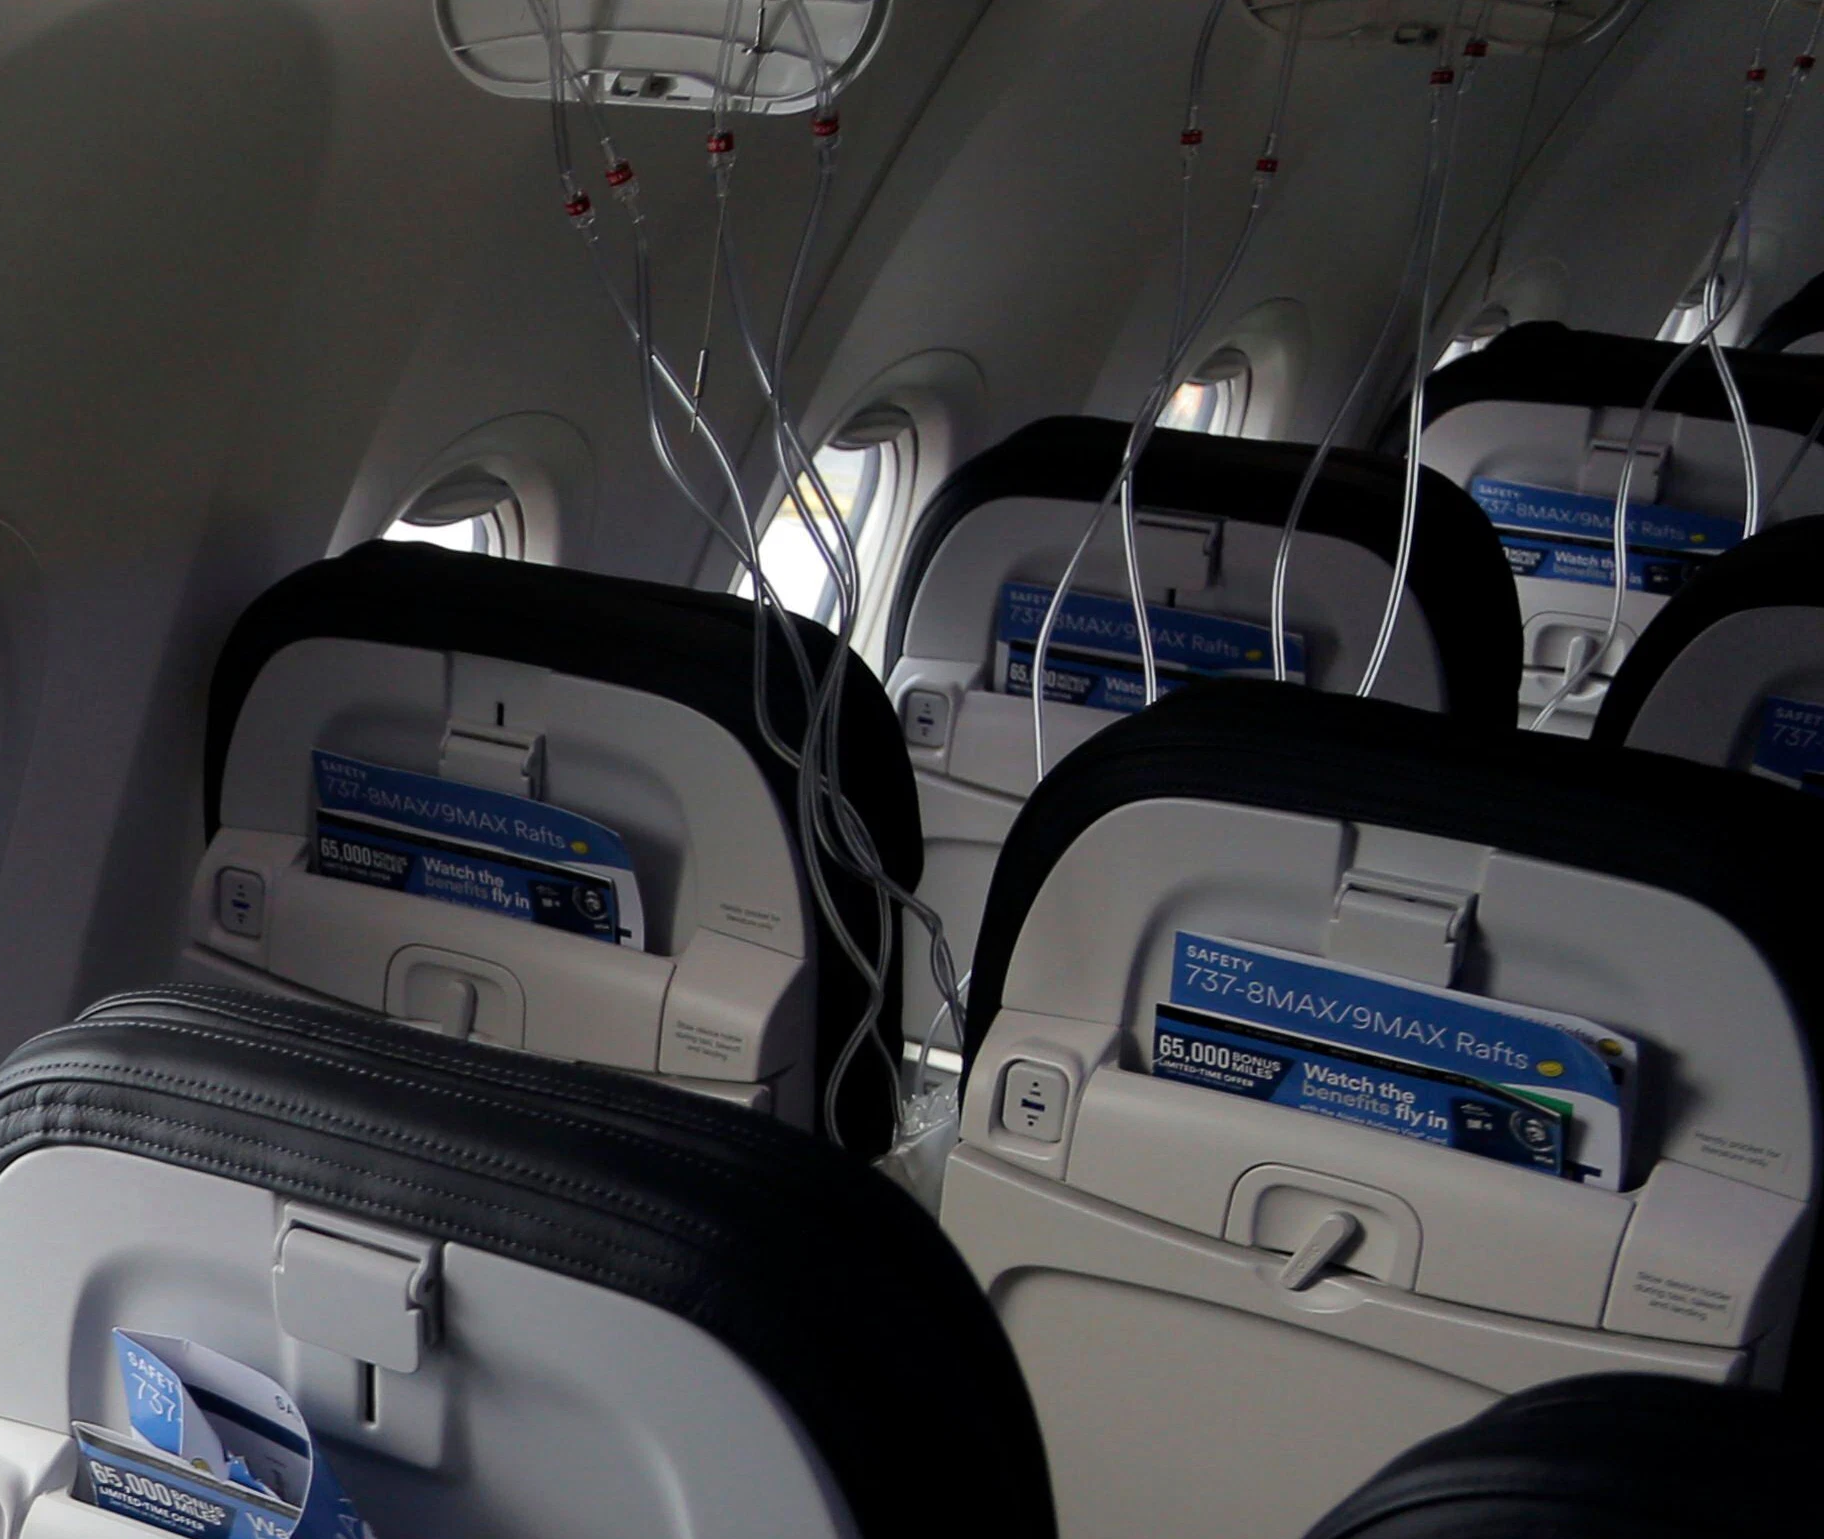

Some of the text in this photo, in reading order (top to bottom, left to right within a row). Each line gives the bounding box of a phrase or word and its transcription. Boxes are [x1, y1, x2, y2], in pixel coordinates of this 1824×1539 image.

[1641, 521, 1685, 541] Rafts
[1554, 550, 1599, 567] Watch
[1192, 635, 1241, 660] Rafts
[320, 759, 367, 781] SAFETY
[326, 775, 566, 849] 737-8MAX/9MAX Rafts
[320, 838, 372, 867] 65,000
[422, 856, 505, 889] Watch the
[423, 874, 530, 912] benefits fly in
[1185, 944, 1254, 974] SAFETY
[1184, 963, 1449, 1050] 737-8MAX/9MAX
[1455, 1030, 1530, 1071] Rafts
[1158, 1034, 1231, 1070] 65,000
[1232, 1051, 1283, 1073] BONUS
[1223, 1073, 1255, 1088] OFFER
[1231, 1062, 1274, 1081] MILES
[1303, 1061, 1375, 1095] Watch
[1379, 1078, 1417, 1105] the
[1303, 1079, 1449, 1132] benefits fly in
[89, 1461, 174, 1508] 65,000
[98, 1485, 171, 1521] LIMITED-TIME
[171, 1511, 206, 1533] OFFER
[171, 1487, 227, 1519] BONUS
[173, 1499, 223, 1527] MILES
